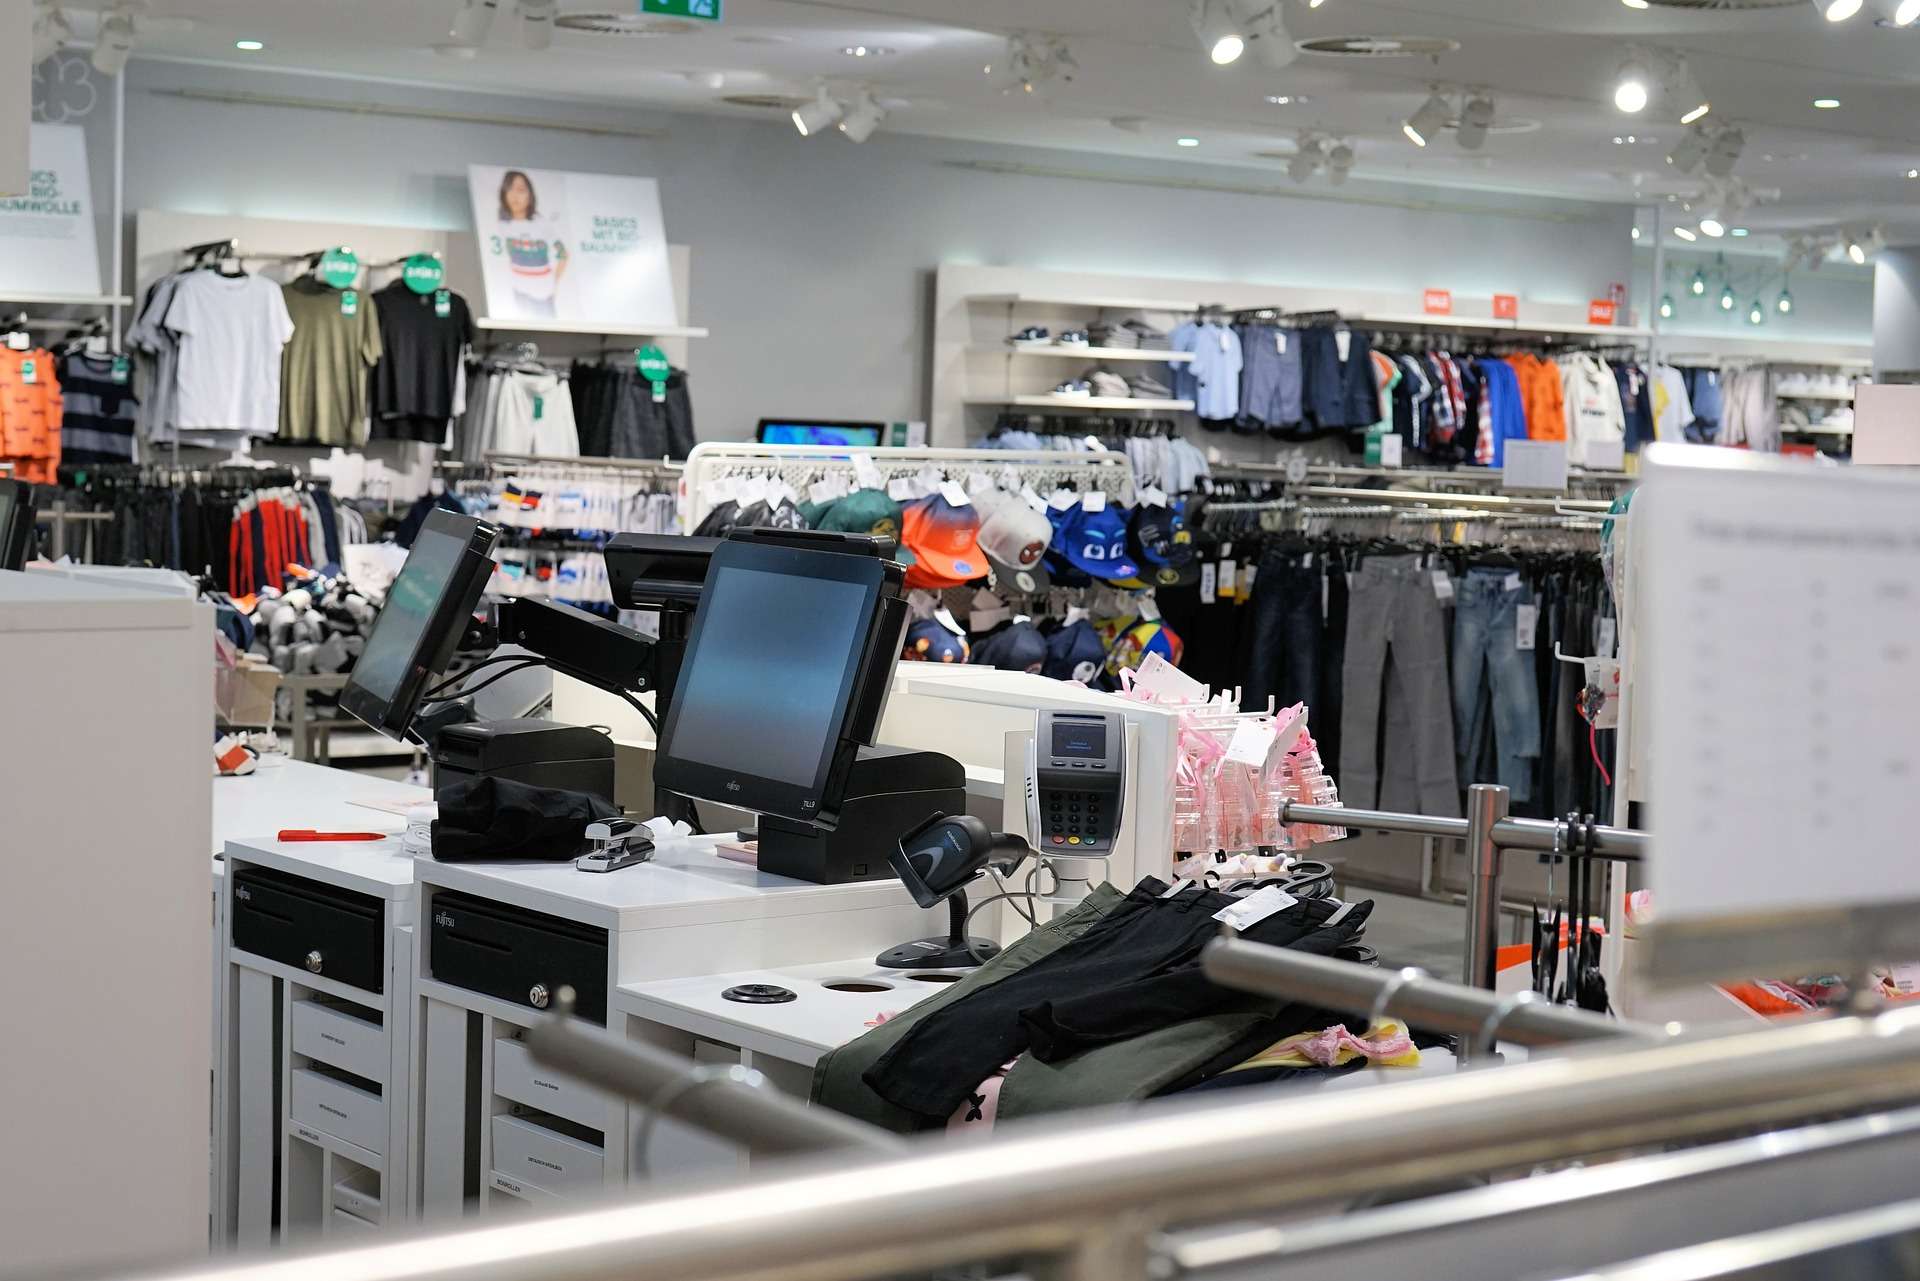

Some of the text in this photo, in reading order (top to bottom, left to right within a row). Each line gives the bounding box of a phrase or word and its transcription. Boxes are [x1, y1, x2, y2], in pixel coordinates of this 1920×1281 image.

[593, 216, 637, 229] BASICS
[491, 235, 502, 256] 3
[435, 911, 455, 928] FUJITSU
